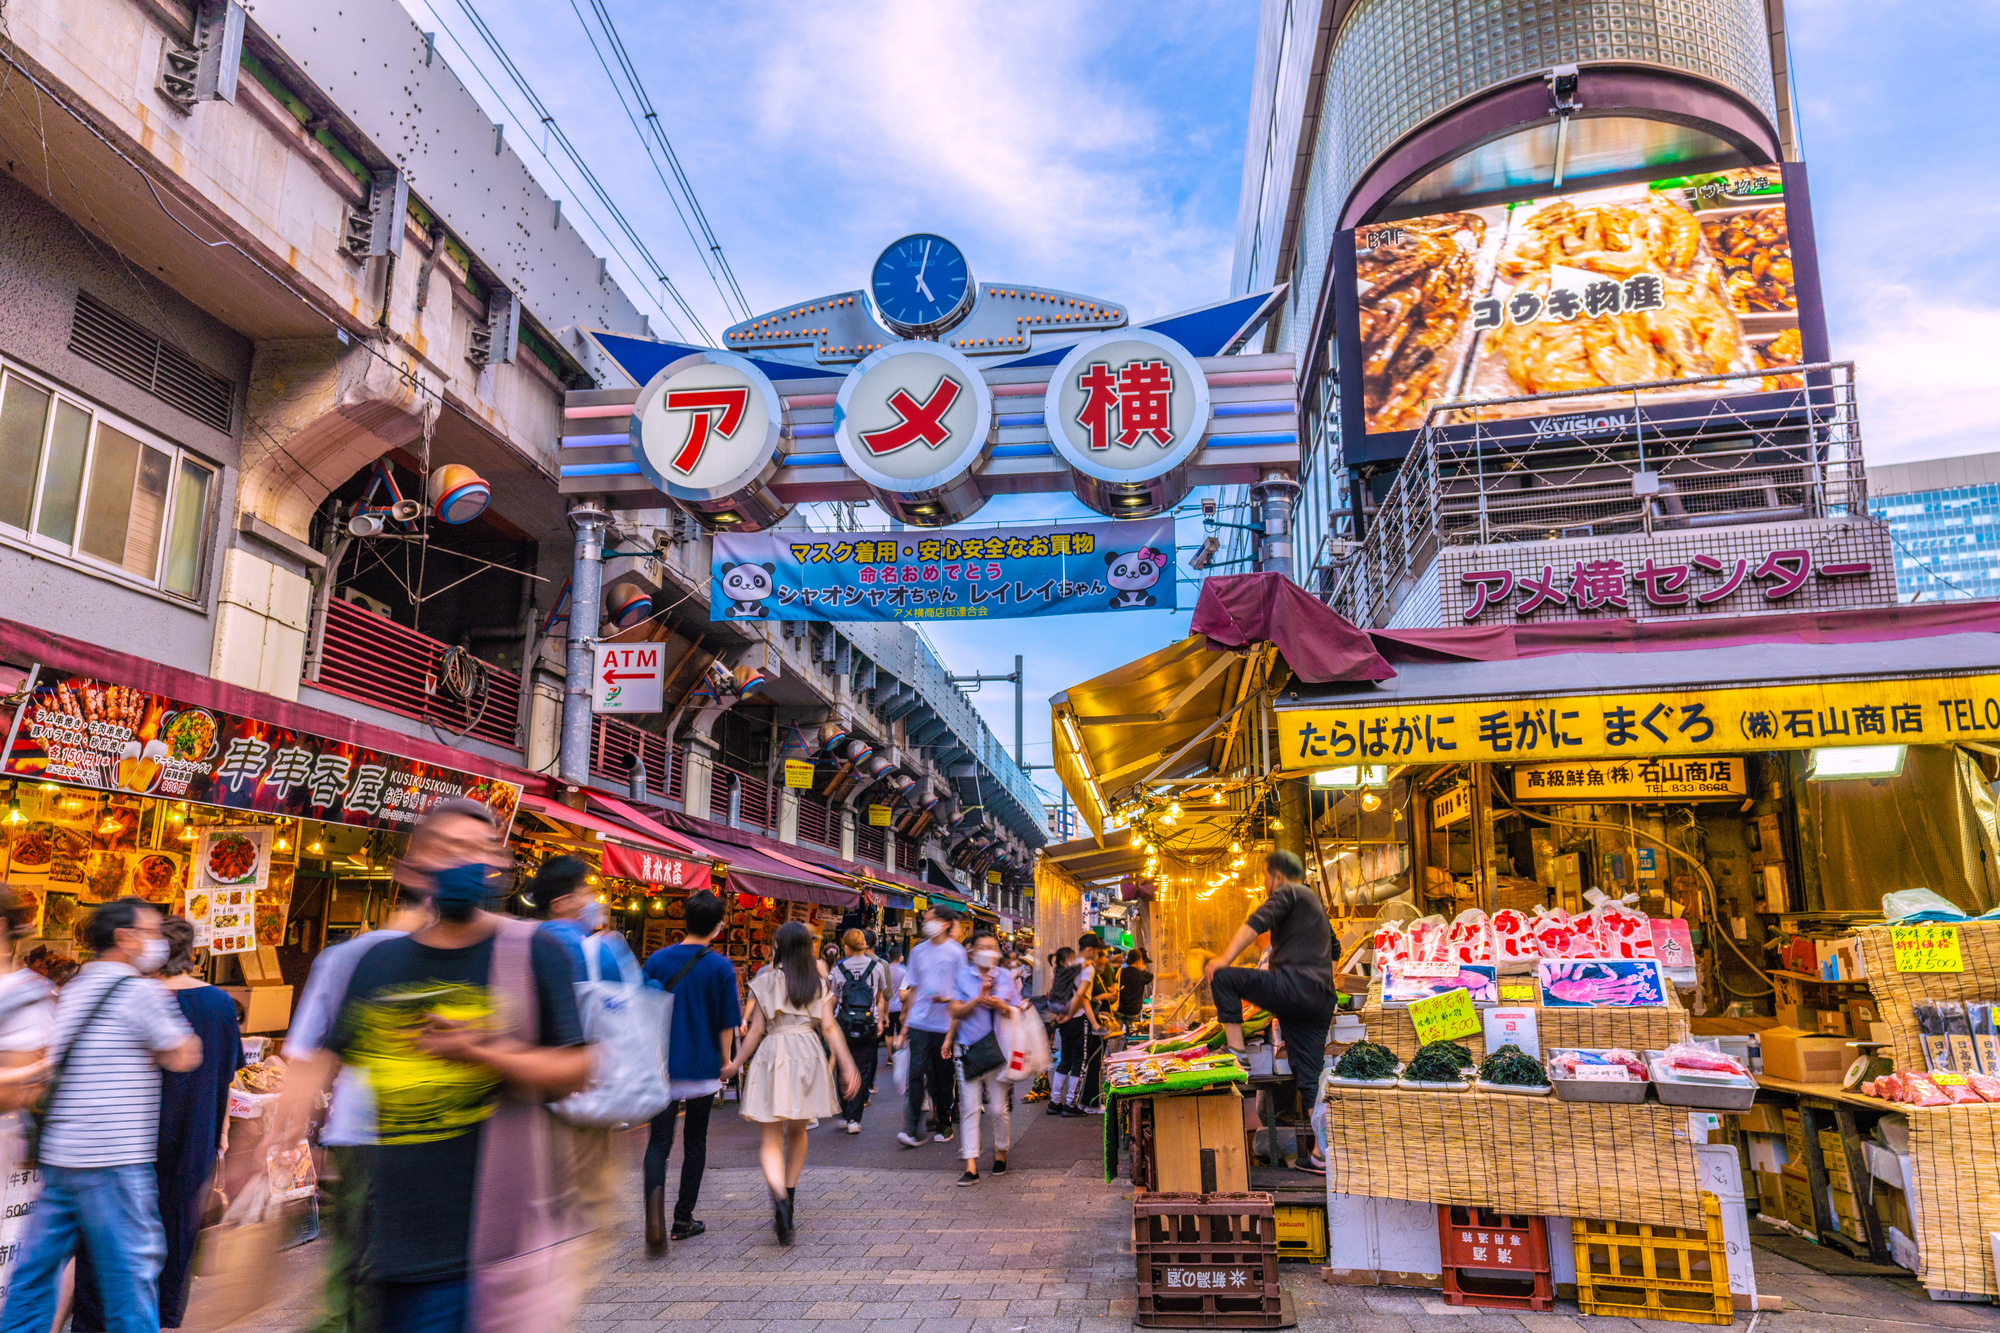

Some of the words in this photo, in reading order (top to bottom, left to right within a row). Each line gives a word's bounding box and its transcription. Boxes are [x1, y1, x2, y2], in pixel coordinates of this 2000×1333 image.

[1683, 175, 1770, 201] コウキ物産
[1366, 228, 1405, 249] B1F
[1470, 272, 1665, 331] コウキ物産
[665, 360, 1175, 475] アメ横
[1553, 414, 1626, 436] VISION
[790, 532, 1095, 565] マスク着用・安心安全なお買物
[858, 562, 1003, 584] 命名おめでとう
[1461, 547, 1874, 622] アメ横センター
[777, 583, 957, 606] シャオシャオちゃん
[969, 579, 1106, 605] レイレイちゃん
[892, 605, 989, 619] アメ横商店街連合会
[602, 649, 657, 668] ATM
[36, 709, 133, 741] ラム串焼き・牛肉串焼き
[1298, 714, 1458, 759] たらばがに
[1478, 706, 1583, 754] 毛がに
[1604, 701, 1716, 747] まぐろ
[1740, 702, 1924, 741] (株)石山商店
[30, 725, 127, 753] 豚バラ焼き・砂肝焼き
[161, 780, 187, 795] 900円
[217, 735, 388, 816] 串串香屋
[389, 770, 462, 797] KUSIKUSIKOUYA
[641, 854, 683, 885] 清水水産
[1893, 928, 1954, 941] 珍味各種
[1894, 938, 1954, 951] 特別価格
[1902, 949, 1938, 959] どれも
[1472, 1246, 1513, 1264] 清酒
[1167, 1271, 1227, 1289] 新潟の酒
